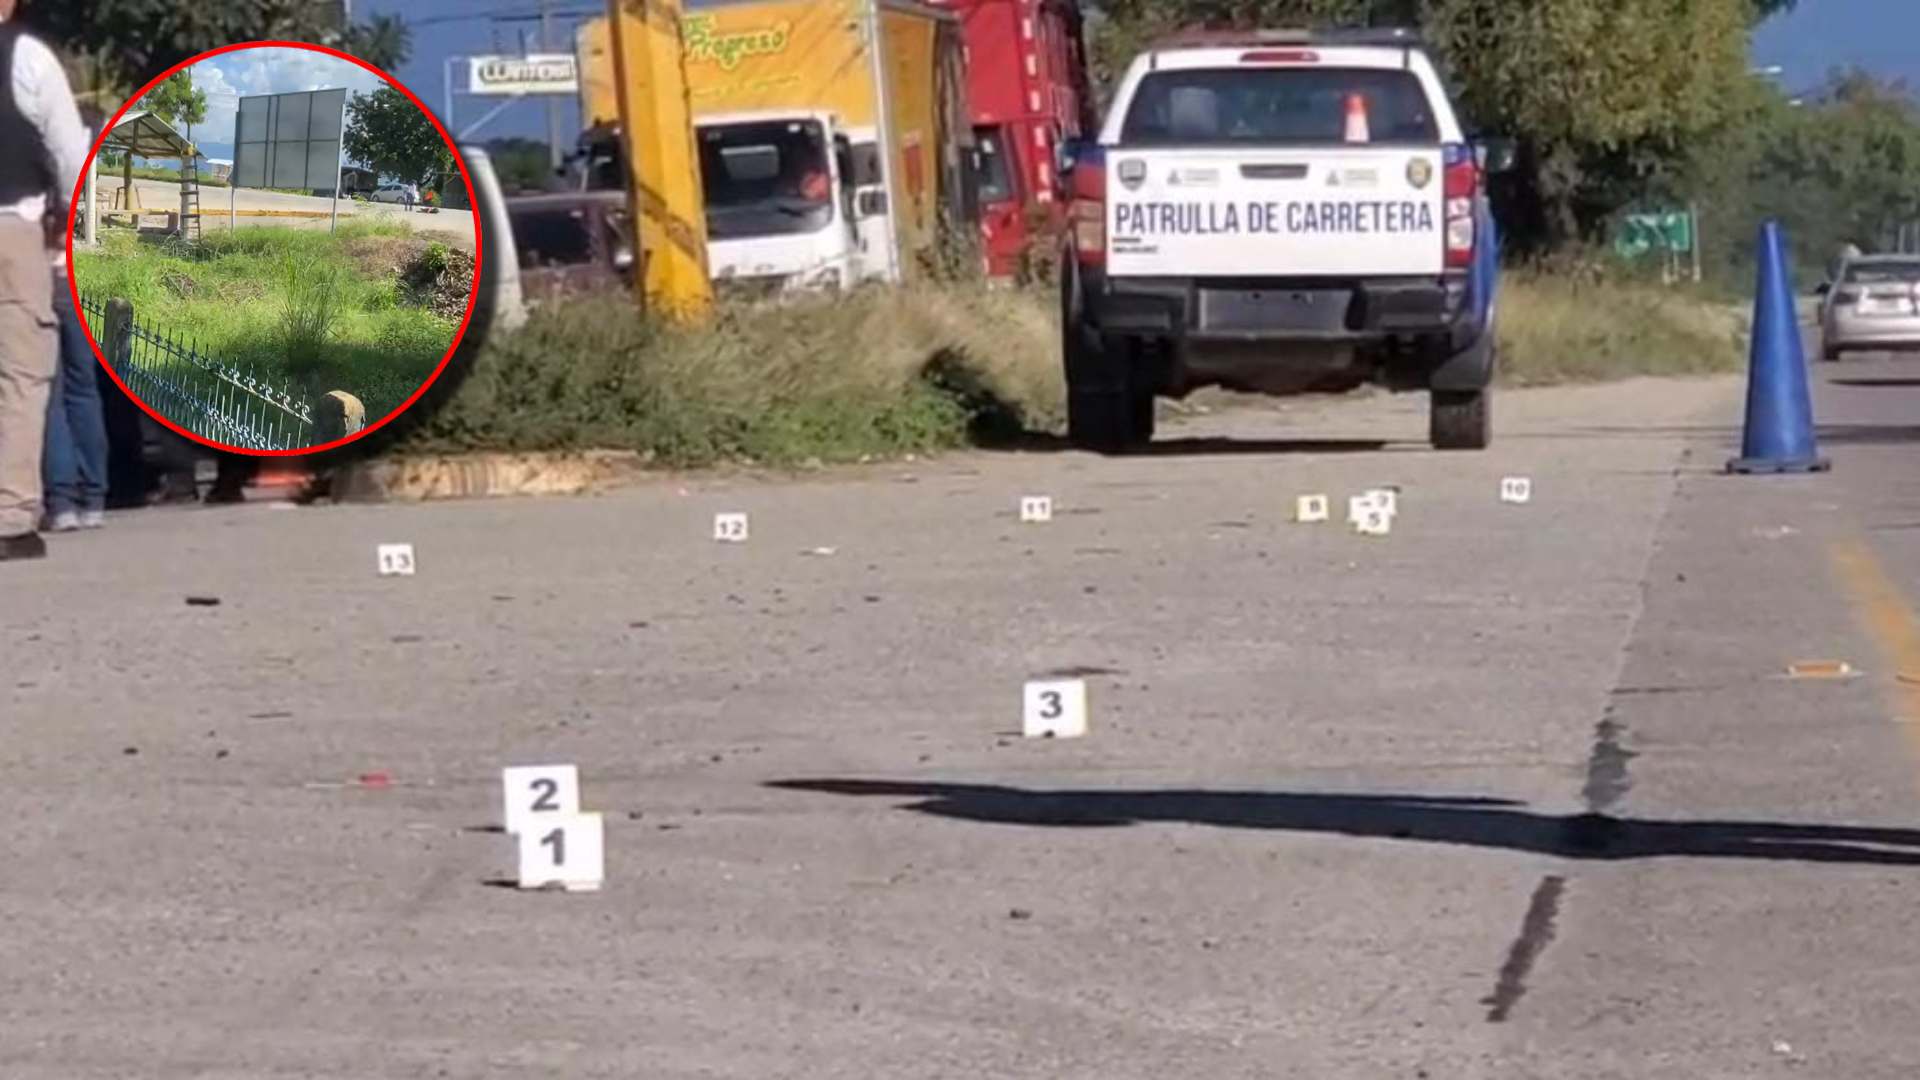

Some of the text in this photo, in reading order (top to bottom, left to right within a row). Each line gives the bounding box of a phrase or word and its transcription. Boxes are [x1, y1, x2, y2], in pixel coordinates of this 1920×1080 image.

[687, 30, 787, 69] Progreso
[1115, 201, 1433, 234] PATRULLA DE CARRETERA
[1506, 483, 1526, 498] 10
[1027, 501, 1047, 514] 11
[719, 519, 743, 536] 12
[383, 552, 410, 570] 13
[1038, 691, 1063, 719] 3
[530, 778, 559, 812] 2
[541, 829, 564, 866] 1
